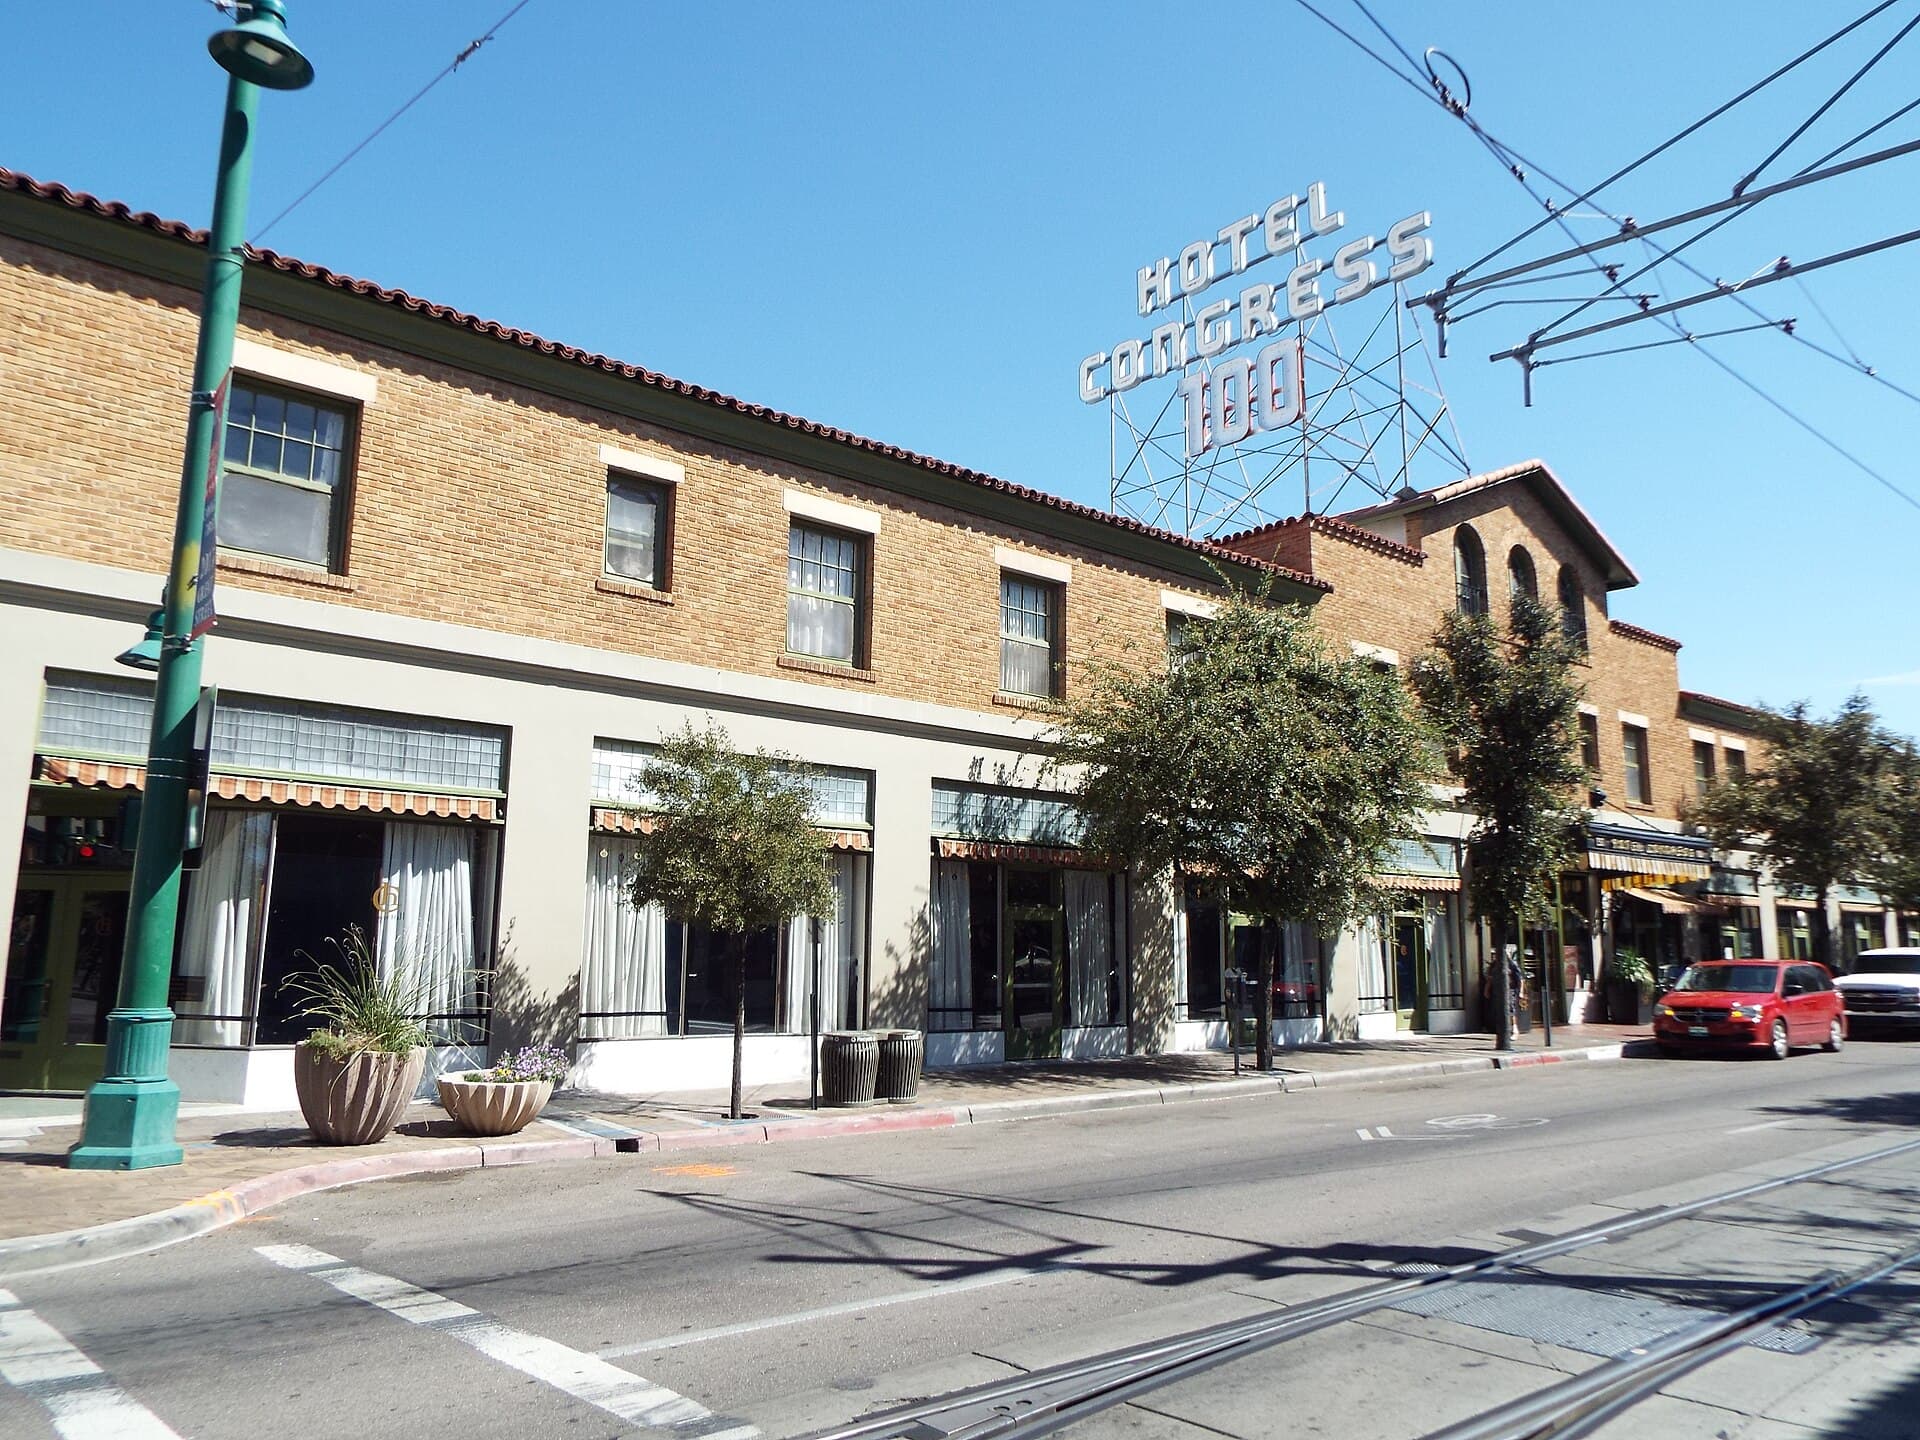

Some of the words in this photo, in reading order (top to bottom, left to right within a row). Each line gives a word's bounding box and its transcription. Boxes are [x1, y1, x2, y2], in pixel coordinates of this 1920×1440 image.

[1079, 211, 1433, 404] CONGRESS
[1136, 181, 1344, 316] HOTEL
[1177, 337, 1304, 457] 100
